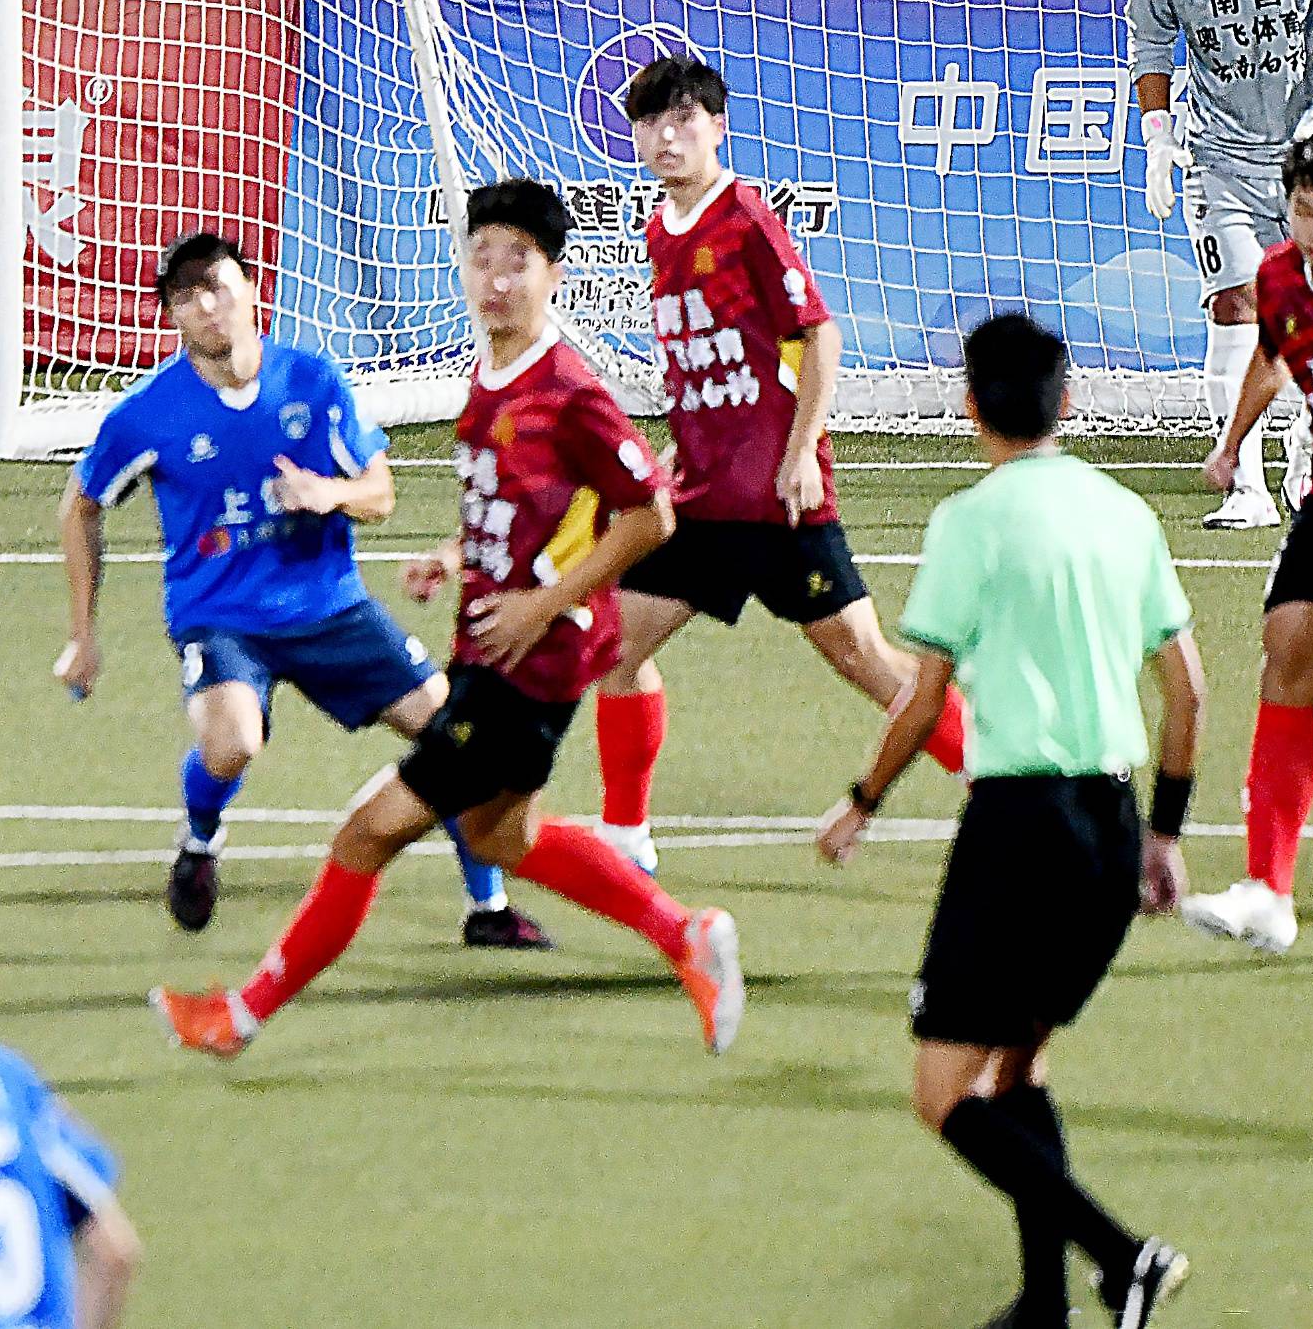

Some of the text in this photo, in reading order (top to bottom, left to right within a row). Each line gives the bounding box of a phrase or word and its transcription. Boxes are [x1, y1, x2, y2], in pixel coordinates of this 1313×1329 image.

[1195, 9, 1308, 53] 奥飞体育
[1194, 234, 1222, 279] 18
